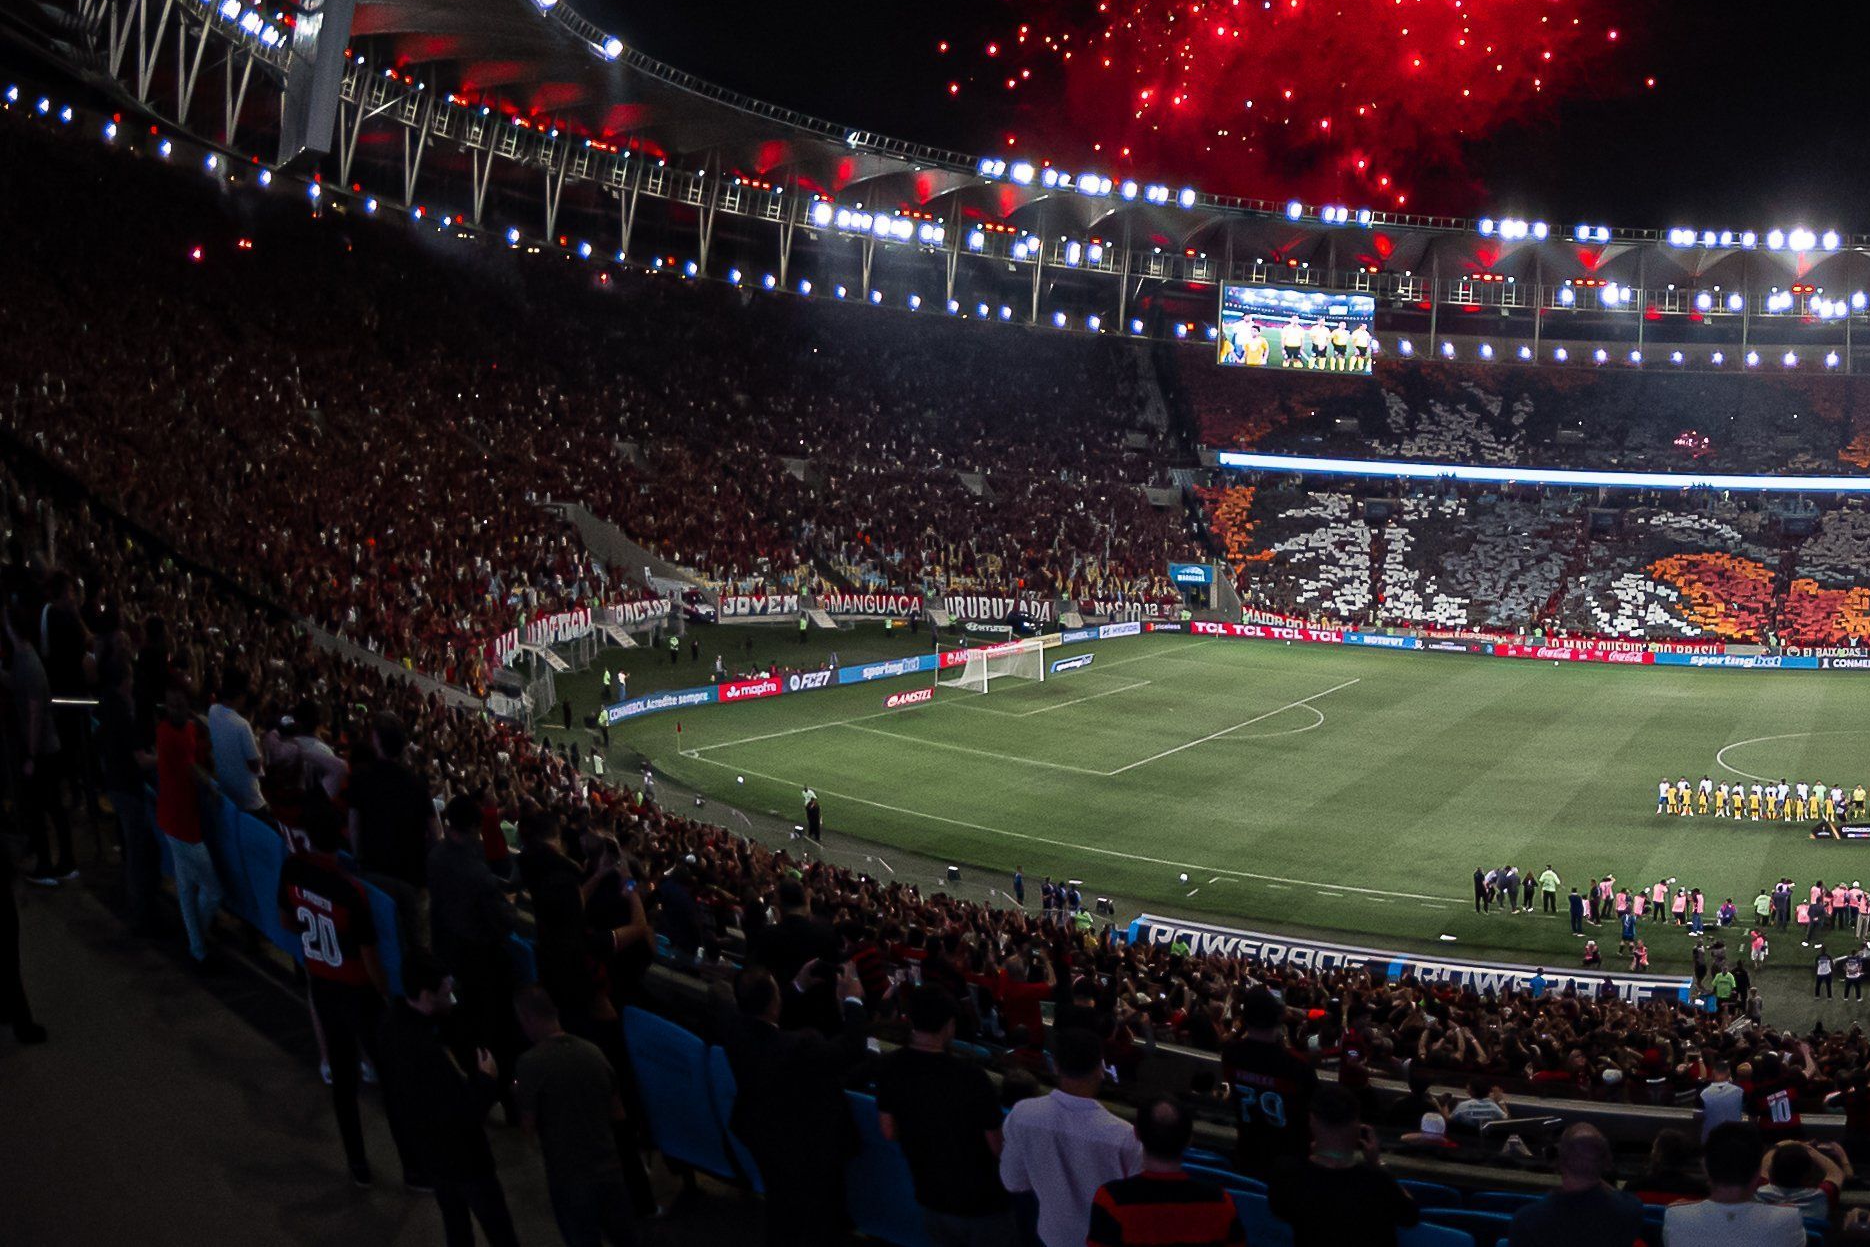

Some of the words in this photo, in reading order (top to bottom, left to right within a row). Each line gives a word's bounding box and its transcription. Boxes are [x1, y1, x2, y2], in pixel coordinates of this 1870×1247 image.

[723, 595, 798, 615] JOVEM
[944, 596, 1050, 622] URUBUZADA
[1195, 622, 1227, 634] TCL
[1232, 624, 1265, 637] TCL
[1271, 627, 1303, 639] TCL
[1309, 629, 1341, 642] TCL
[1537, 647, 1571, 660] Coca-Cola
[1608, 650, 1643, 663] Coca-Cola
[1690, 655, 1782, 667] sportingbet
[863, 656, 920, 679] sportingbet
[741, 681, 777, 698] mapfre
[898, 689, 934, 706] AMSTEL
[296, 906, 343, 967] 20
[1149, 924, 1370, 970] POWERADE
[1413, 963, 1653, 1007] POWEAE
[1768, 1097, 1792, 1123] 10
